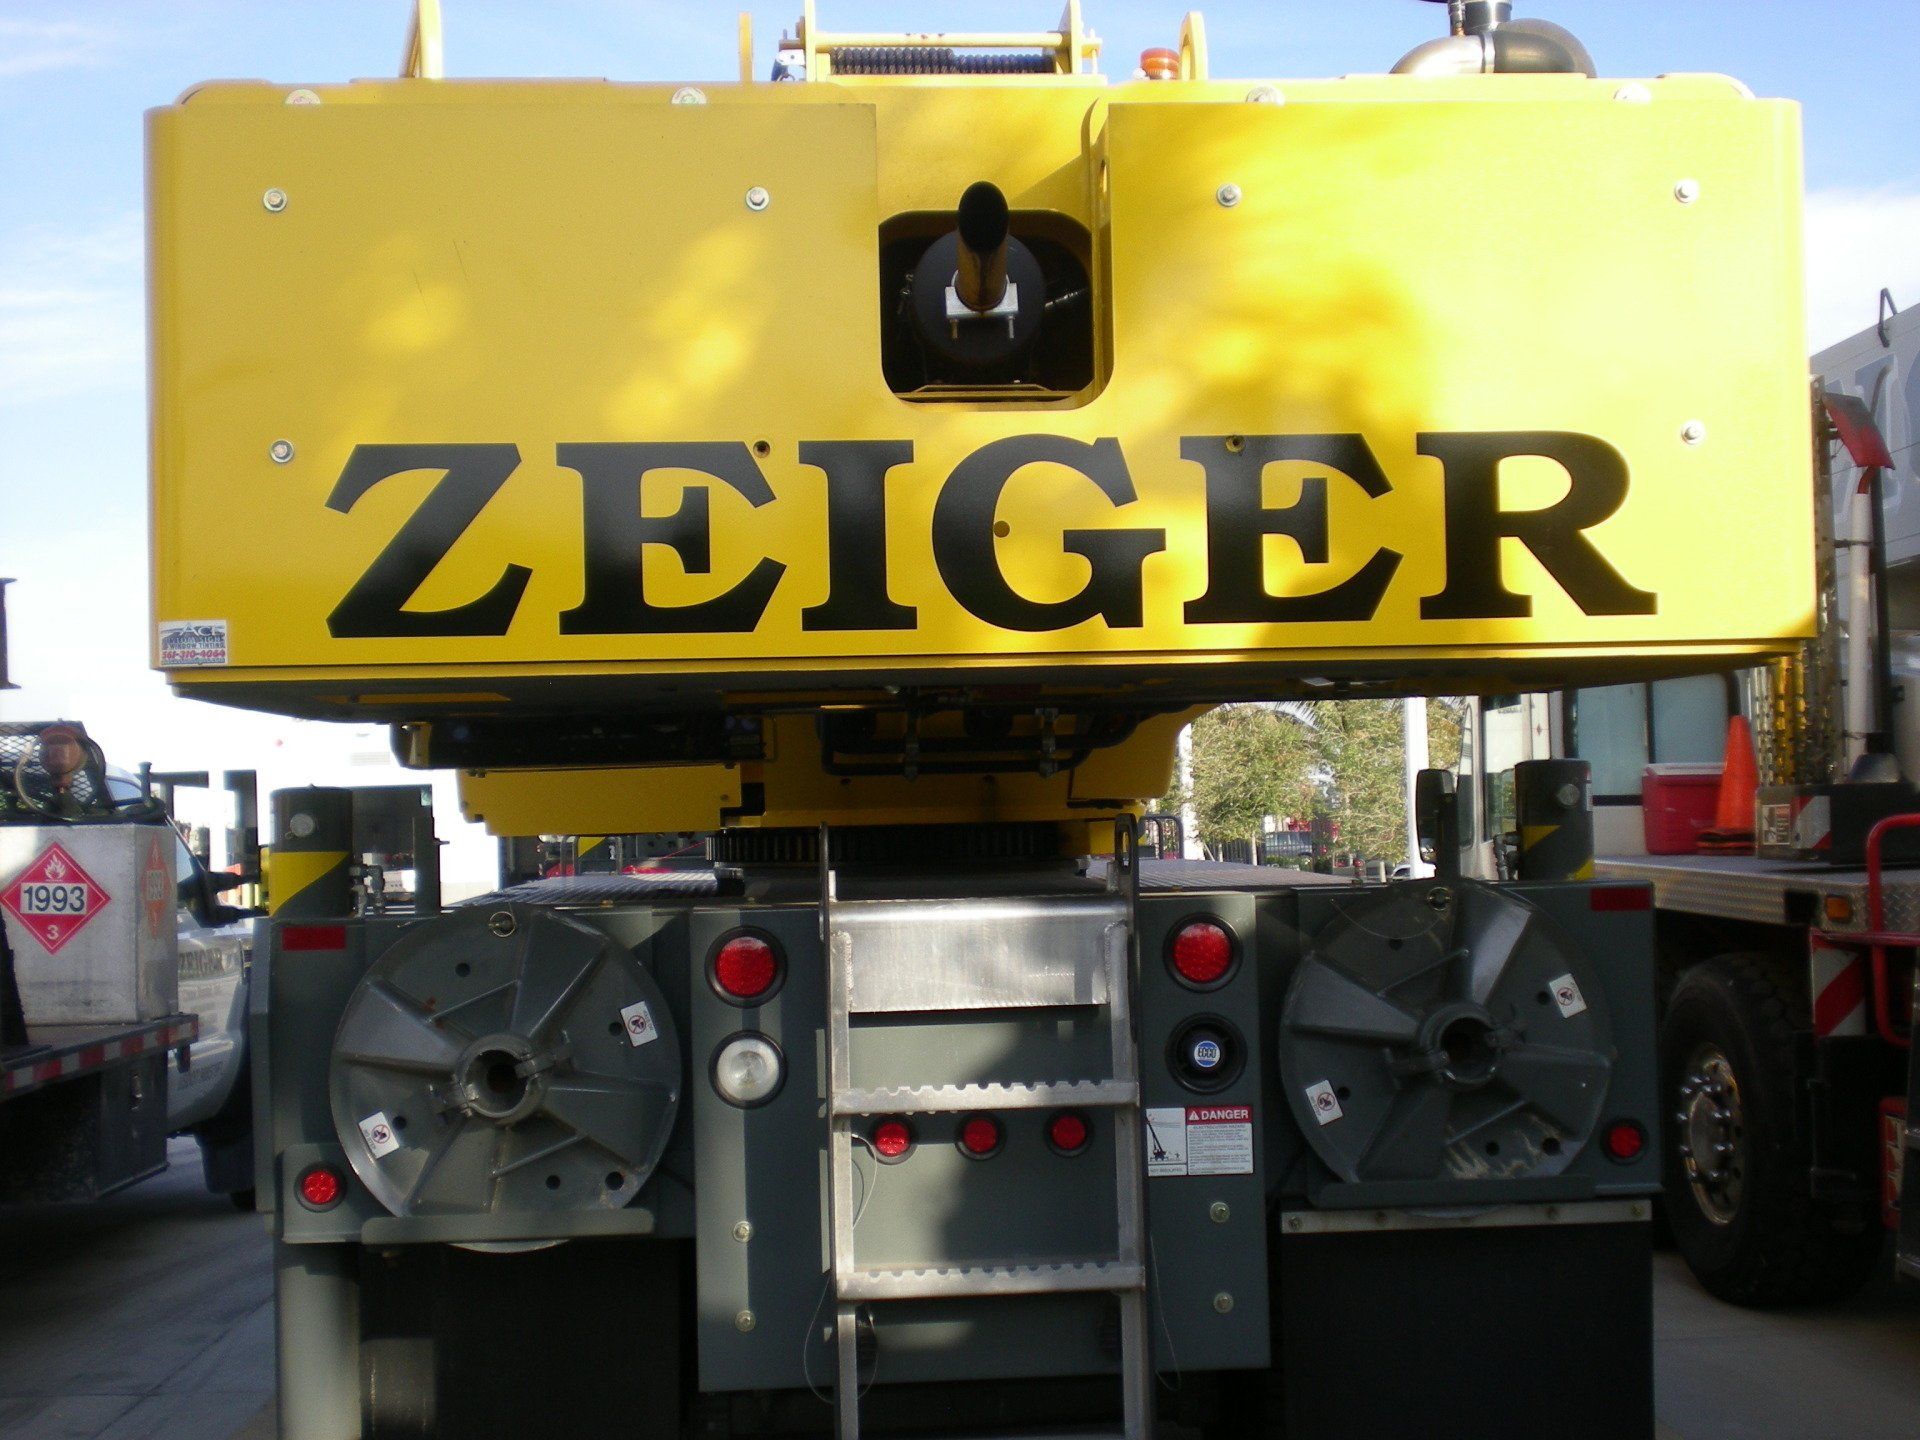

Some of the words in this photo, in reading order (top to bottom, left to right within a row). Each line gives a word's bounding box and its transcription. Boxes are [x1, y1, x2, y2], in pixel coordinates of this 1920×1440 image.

[325, 431, 1657, 638] ZEIGER
[23, 886, 85, 912] 1993
[47, 925, 59, 940] 3
[1201, 1109, 1249, 1121] DANGER
